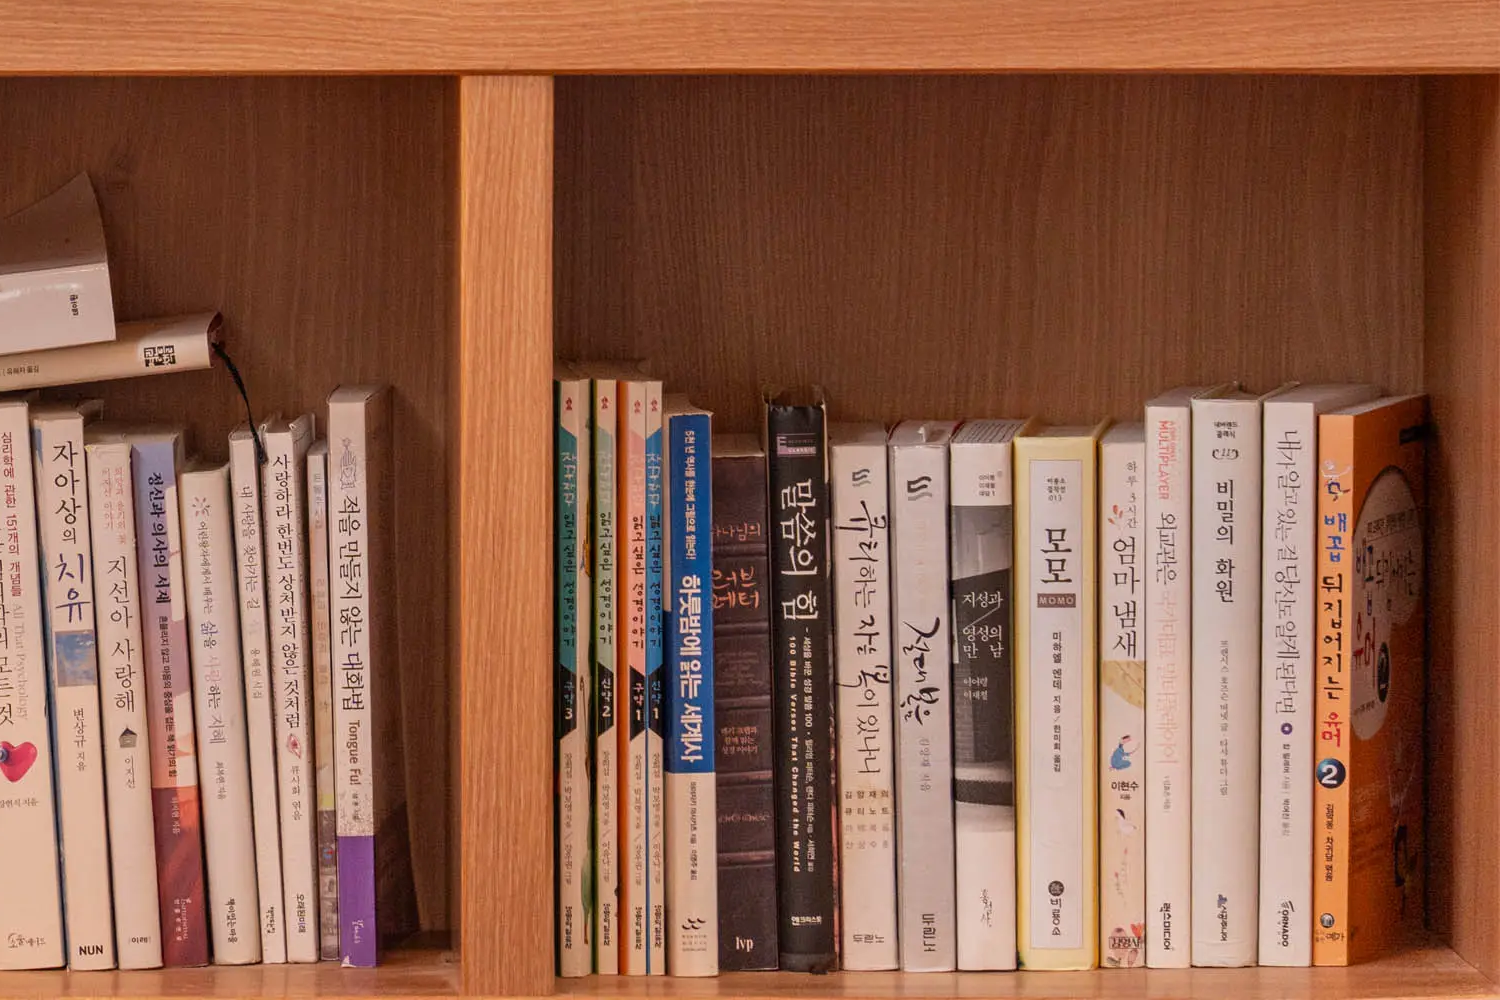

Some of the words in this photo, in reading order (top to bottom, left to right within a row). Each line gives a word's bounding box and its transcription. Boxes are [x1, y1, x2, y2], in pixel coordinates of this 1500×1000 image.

[1, 432, 14, 479] 심리학에
[1158, 420, 1169, 500] MULTIPLAYER
[4, 484, 16, 508] 관한
[53, 440, 81, 544] 자아상의
[148, 472, 165, 517] 정신과
[240, 486, 252, 498] 내
[1216, 480, 1233, 545] 비밀의
[6, 514, 19, 555] 151개의
[241, 504, 254, 539] 사랑을
[339, 495, 360, 537] 적을
[781, 478, 817, 577] 말씀의
[151, 523, 168, 567] 의사의
[835, 500, 887, 608] 큐티하는
[1041, 528, 1073, 584] 모모
[1113, 536, 1140, 595] 엄마
[10, 561, 22, 598] 개념들
[56, 553, 91, 623] 치유
[156, 574, 171, 604] 서재
[244, 545, 257, 592] 찾아가는
[340, 540, 362, 600] 만들지
[1216, 559, 1234, 603] 화원
[108, 555, 133, 629] 지선아
[246, 598, 260, 610] 길
[781, 590, 818, 620] 힘
[963, 591, 1004, 608] 지성과
[1039, 596, 1074, 605] MOMO
[201, 621, 218, 648] 삶을
[340, 606, 362, 648] 않는
[680, 575, 702, 656] 하룻밤에
[854, 615, 880, 655] 자는
[962, 625, 1002, 642] 영성의
[1113, 600, 1137, 659] 냄새
[112, 639, 136, 712] 사랑해
[203, 655, 221, 709] 사랑하는
[342, 652, 364, 710] 대화법
[680, 660, 702, 699] 읽는
[836, 665, 890, 707] 복이
[73, 708, 87, 747] 변상규
[208, 715, 226, 744] 지혜
[564, 708, 573, 719] 3
[602, 707, 610, 717] 2
[635, 710, 641, 720] 1
[653, 708, 658, 719] 1
[681, 703, 703, 763] 세계사
[77, 752, 86, 771] 지음
[349, 720, 361, 764] Tongue
[857, 715, 880, 774] 있나니
[350, 768, 361, 785] Fu!
[1111, 781, 1140, 791] 이현수
[1321, 764, 1338, 785] 2
[79, 945, 103, 955] NUN
